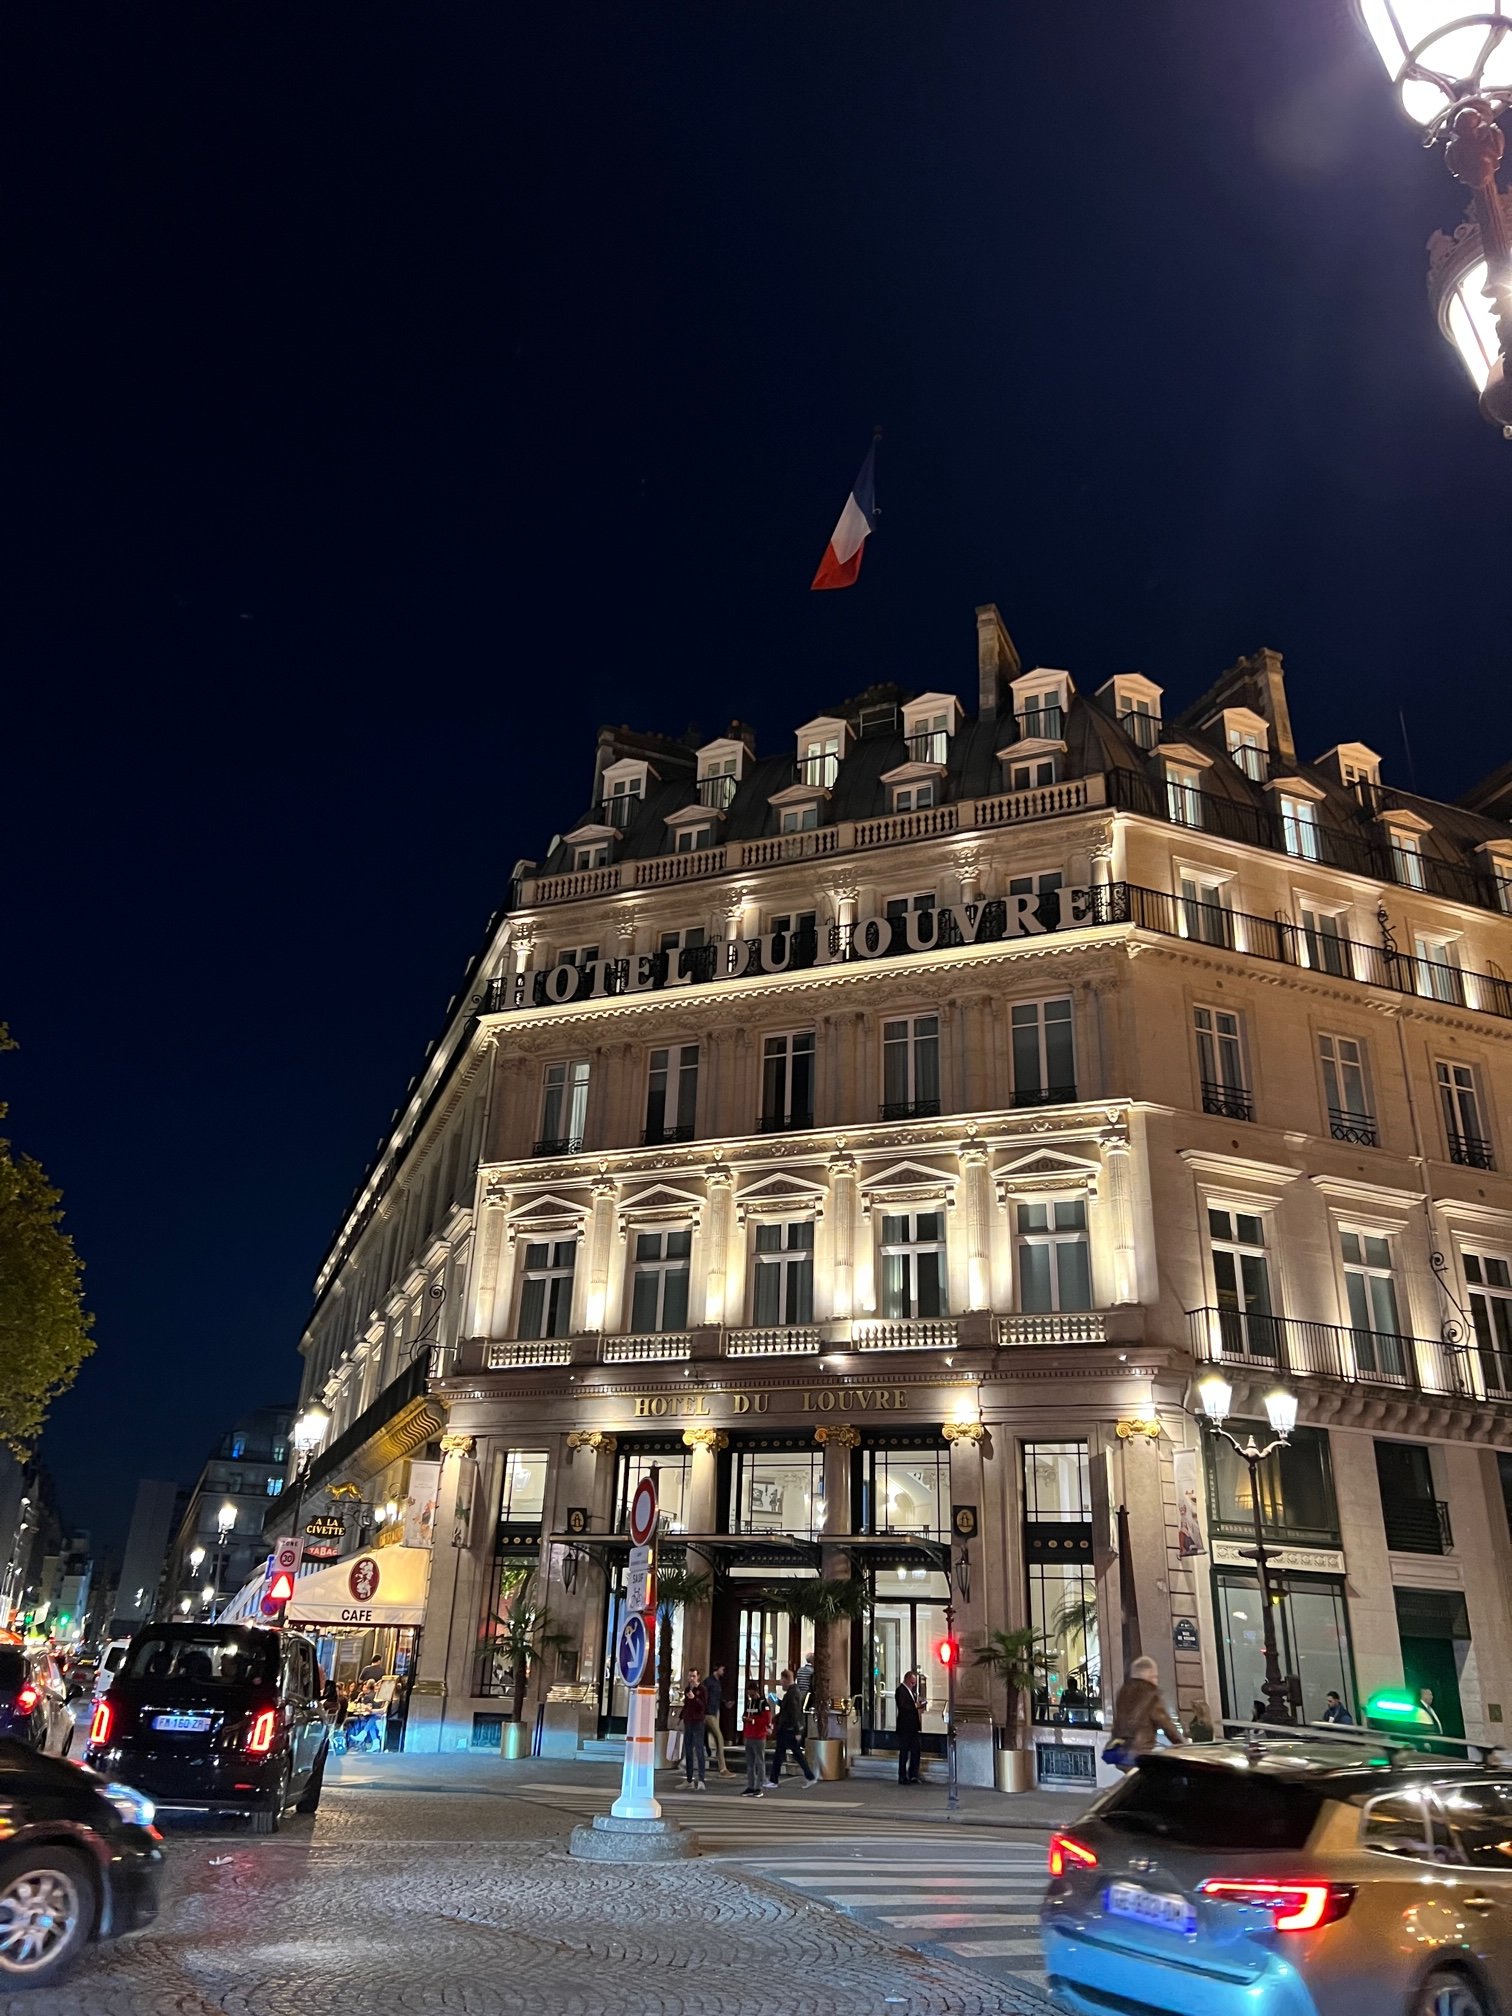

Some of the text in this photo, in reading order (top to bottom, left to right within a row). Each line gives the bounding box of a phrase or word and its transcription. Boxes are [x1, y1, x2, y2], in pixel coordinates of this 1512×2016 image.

[501, 885, 1094, 1009] HOTEL DU LOUVRE
[634, 1390, 908, 1417] HOTEL DU LOUVRE
[315, 1517, 339, 1527] A LA
[306, 1525, 345, 1536] CIVETTE
[309, 1546, 338, 1556] TABAC
[283, 1554, 293, 1563] 30
[341, 1609, 372, 1621] CAFE
